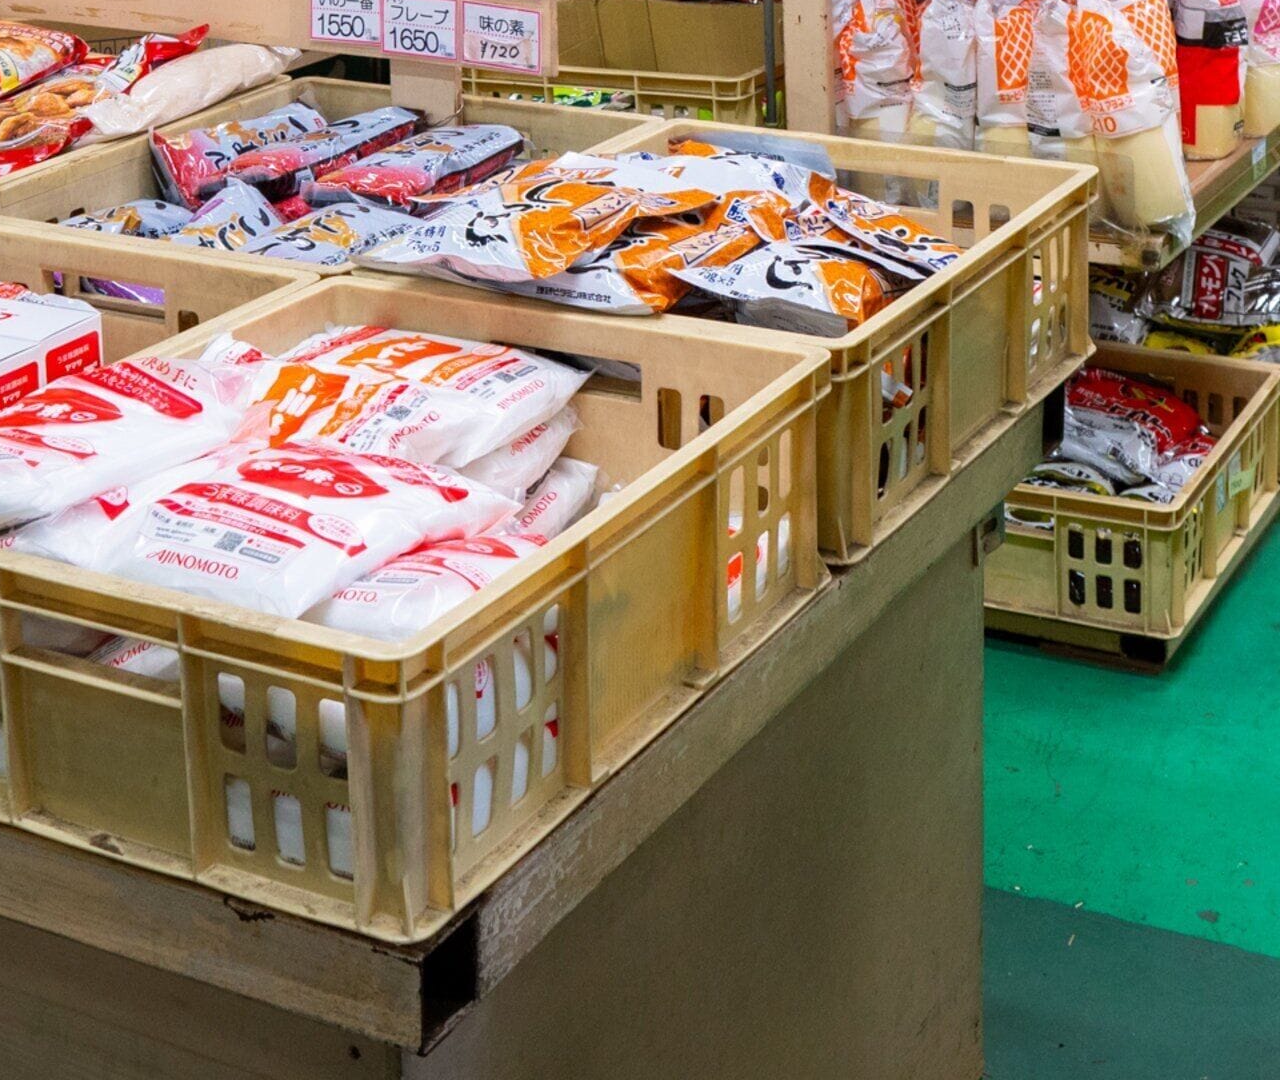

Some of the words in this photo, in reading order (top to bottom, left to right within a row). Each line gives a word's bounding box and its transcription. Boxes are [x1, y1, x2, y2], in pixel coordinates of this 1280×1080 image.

[317, 14, 365, 38] 1550
[479, 15, 525, 37] 味の素
[389, 27, 439, 54] 1650
[204, 484, 303, 521] うま味調味料
[145, 548, 239, 580] AJINOMOTO
